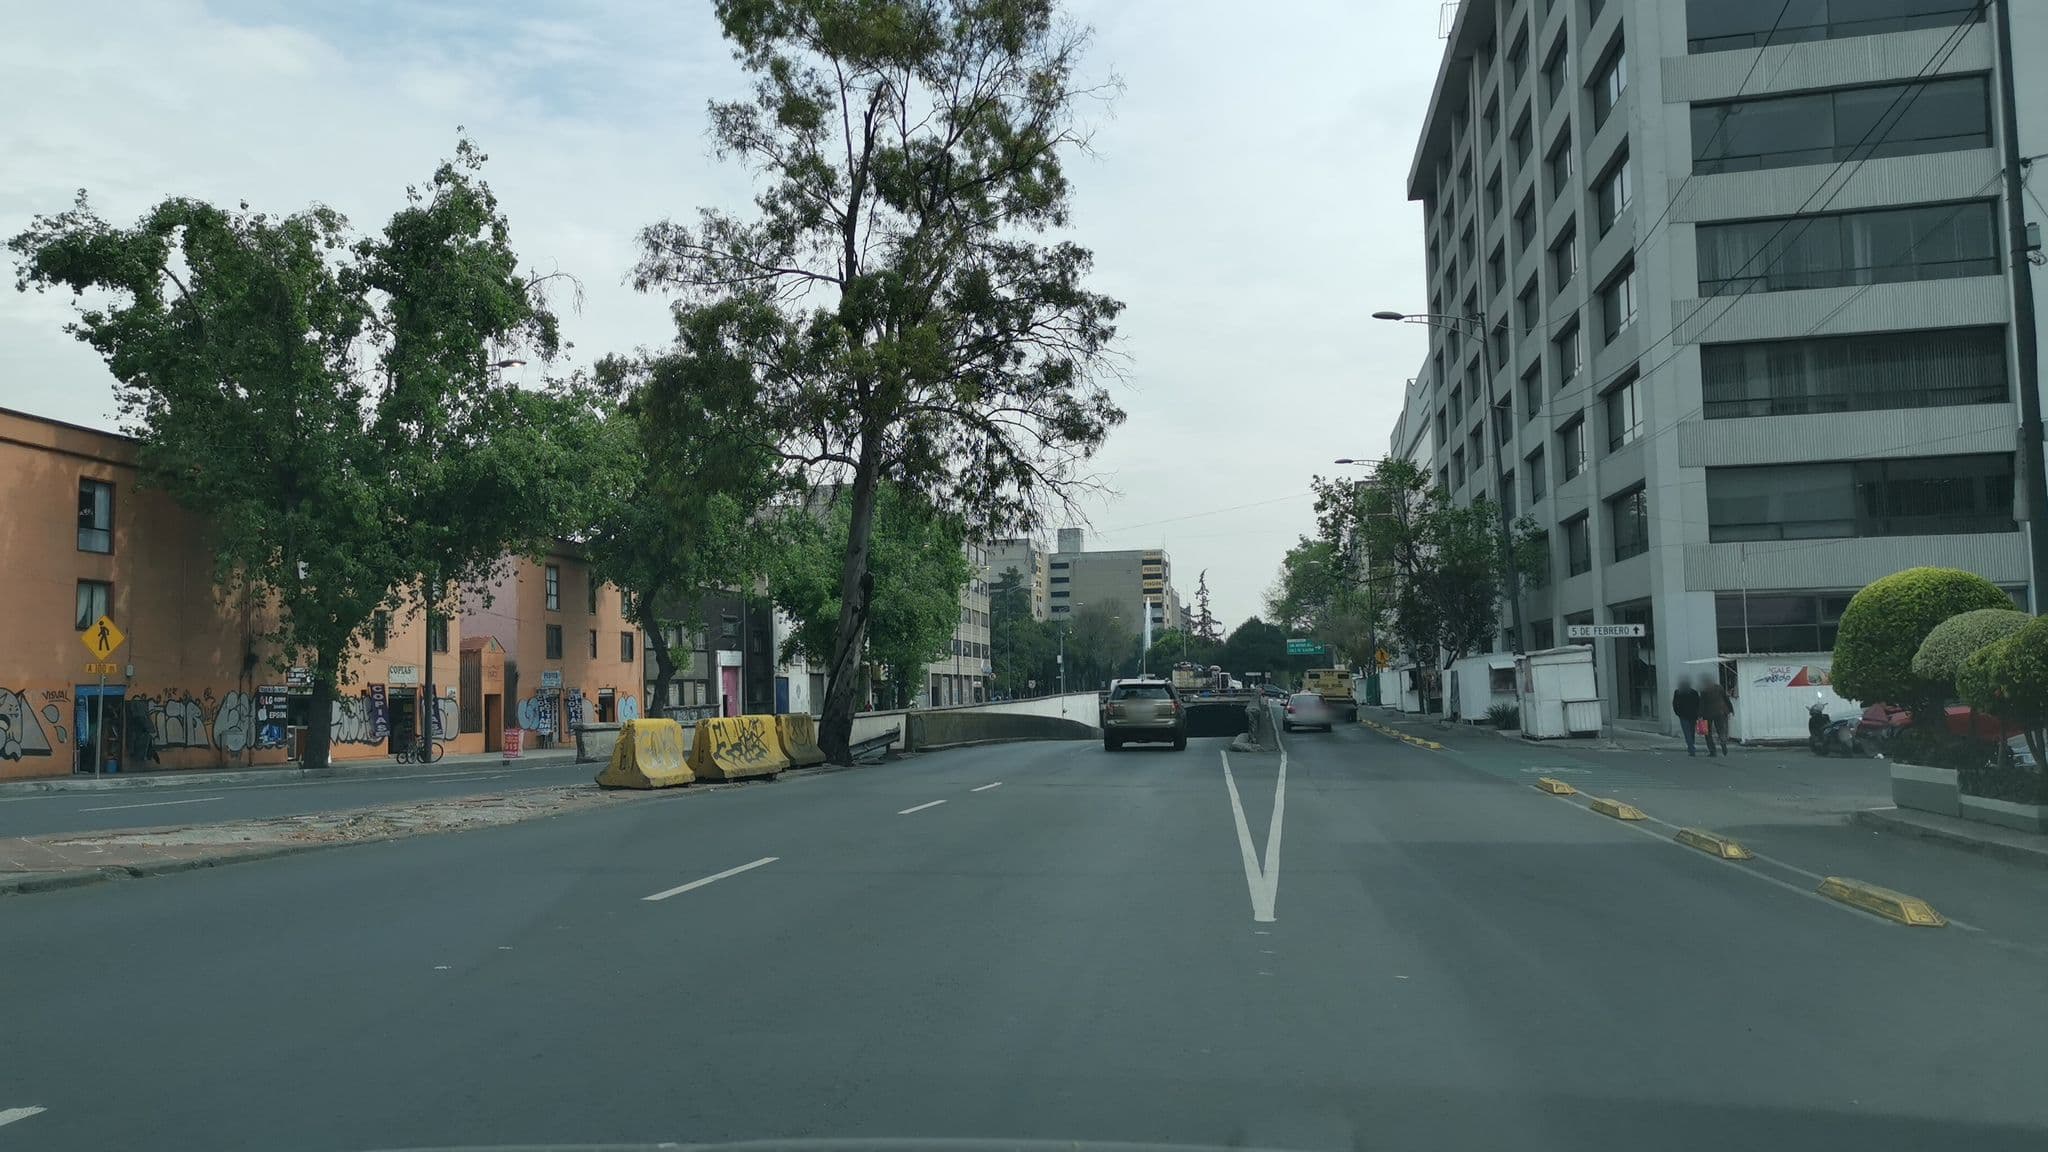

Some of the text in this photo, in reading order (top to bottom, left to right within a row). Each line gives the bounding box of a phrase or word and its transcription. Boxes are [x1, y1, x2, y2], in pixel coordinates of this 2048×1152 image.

[1572, 626, 1630, 636] 5 DE FEBRERO
[389, 665, 412, 675] COPIAS
[265, 696, 274, 705] LG
[372, 685, 387, 732] COPIAS
[269, 711, 288, 719] EPSON
